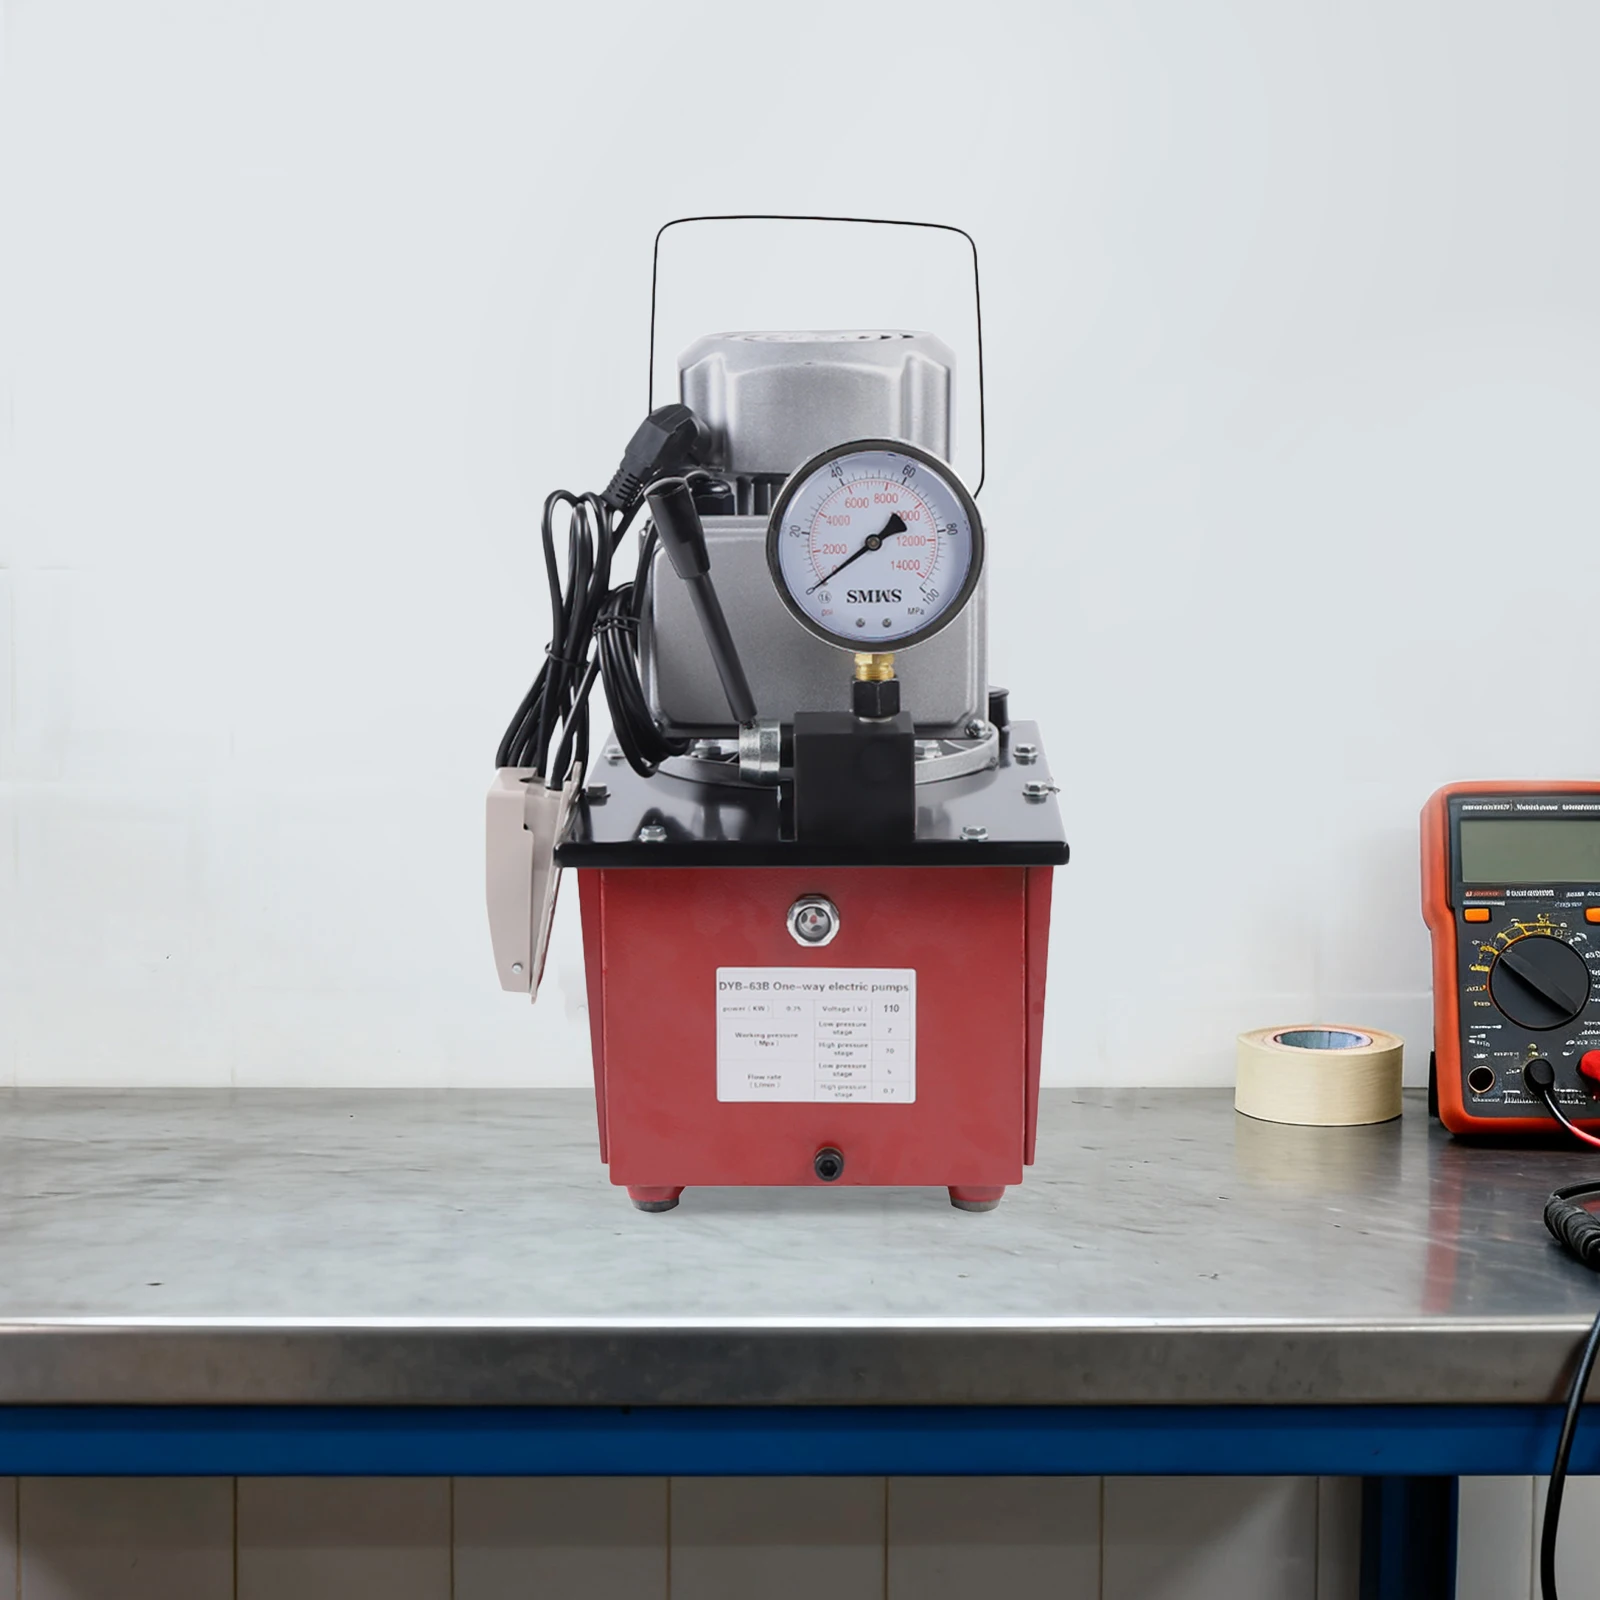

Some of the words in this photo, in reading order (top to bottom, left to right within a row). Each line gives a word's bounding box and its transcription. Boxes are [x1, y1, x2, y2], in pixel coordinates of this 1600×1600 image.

[831, 466, 844, 478] 40
[902, 464, 916, 478] 60
[844, 497, 870, 509] 6000
[873, 493, 899, 504] 8000
[826, 514, 851, 526] 4000
[789, 524, 801, 538] 20
[945, 522, 958, 536] 80
[896, 535, 927, 547] 12000
[822, 543, 848, 555] 2000
[890, 559, 921, 571] 14000
[922, 587, 940, 606] 100
[907, 606, 925, 616] MPa
[718, 981, 770, 992] DYB-63B
[773, 981, 825, 993] One-way
[828, 981, 868, 992] electric
[871, 983, 909, 994] pumps
[822, 1005, 850, 1013] Voltage
[883, 1004, 900, 1013] 110
[818, 1042, 836, 1050] High
[833, 1050, 854, 1058] stage
